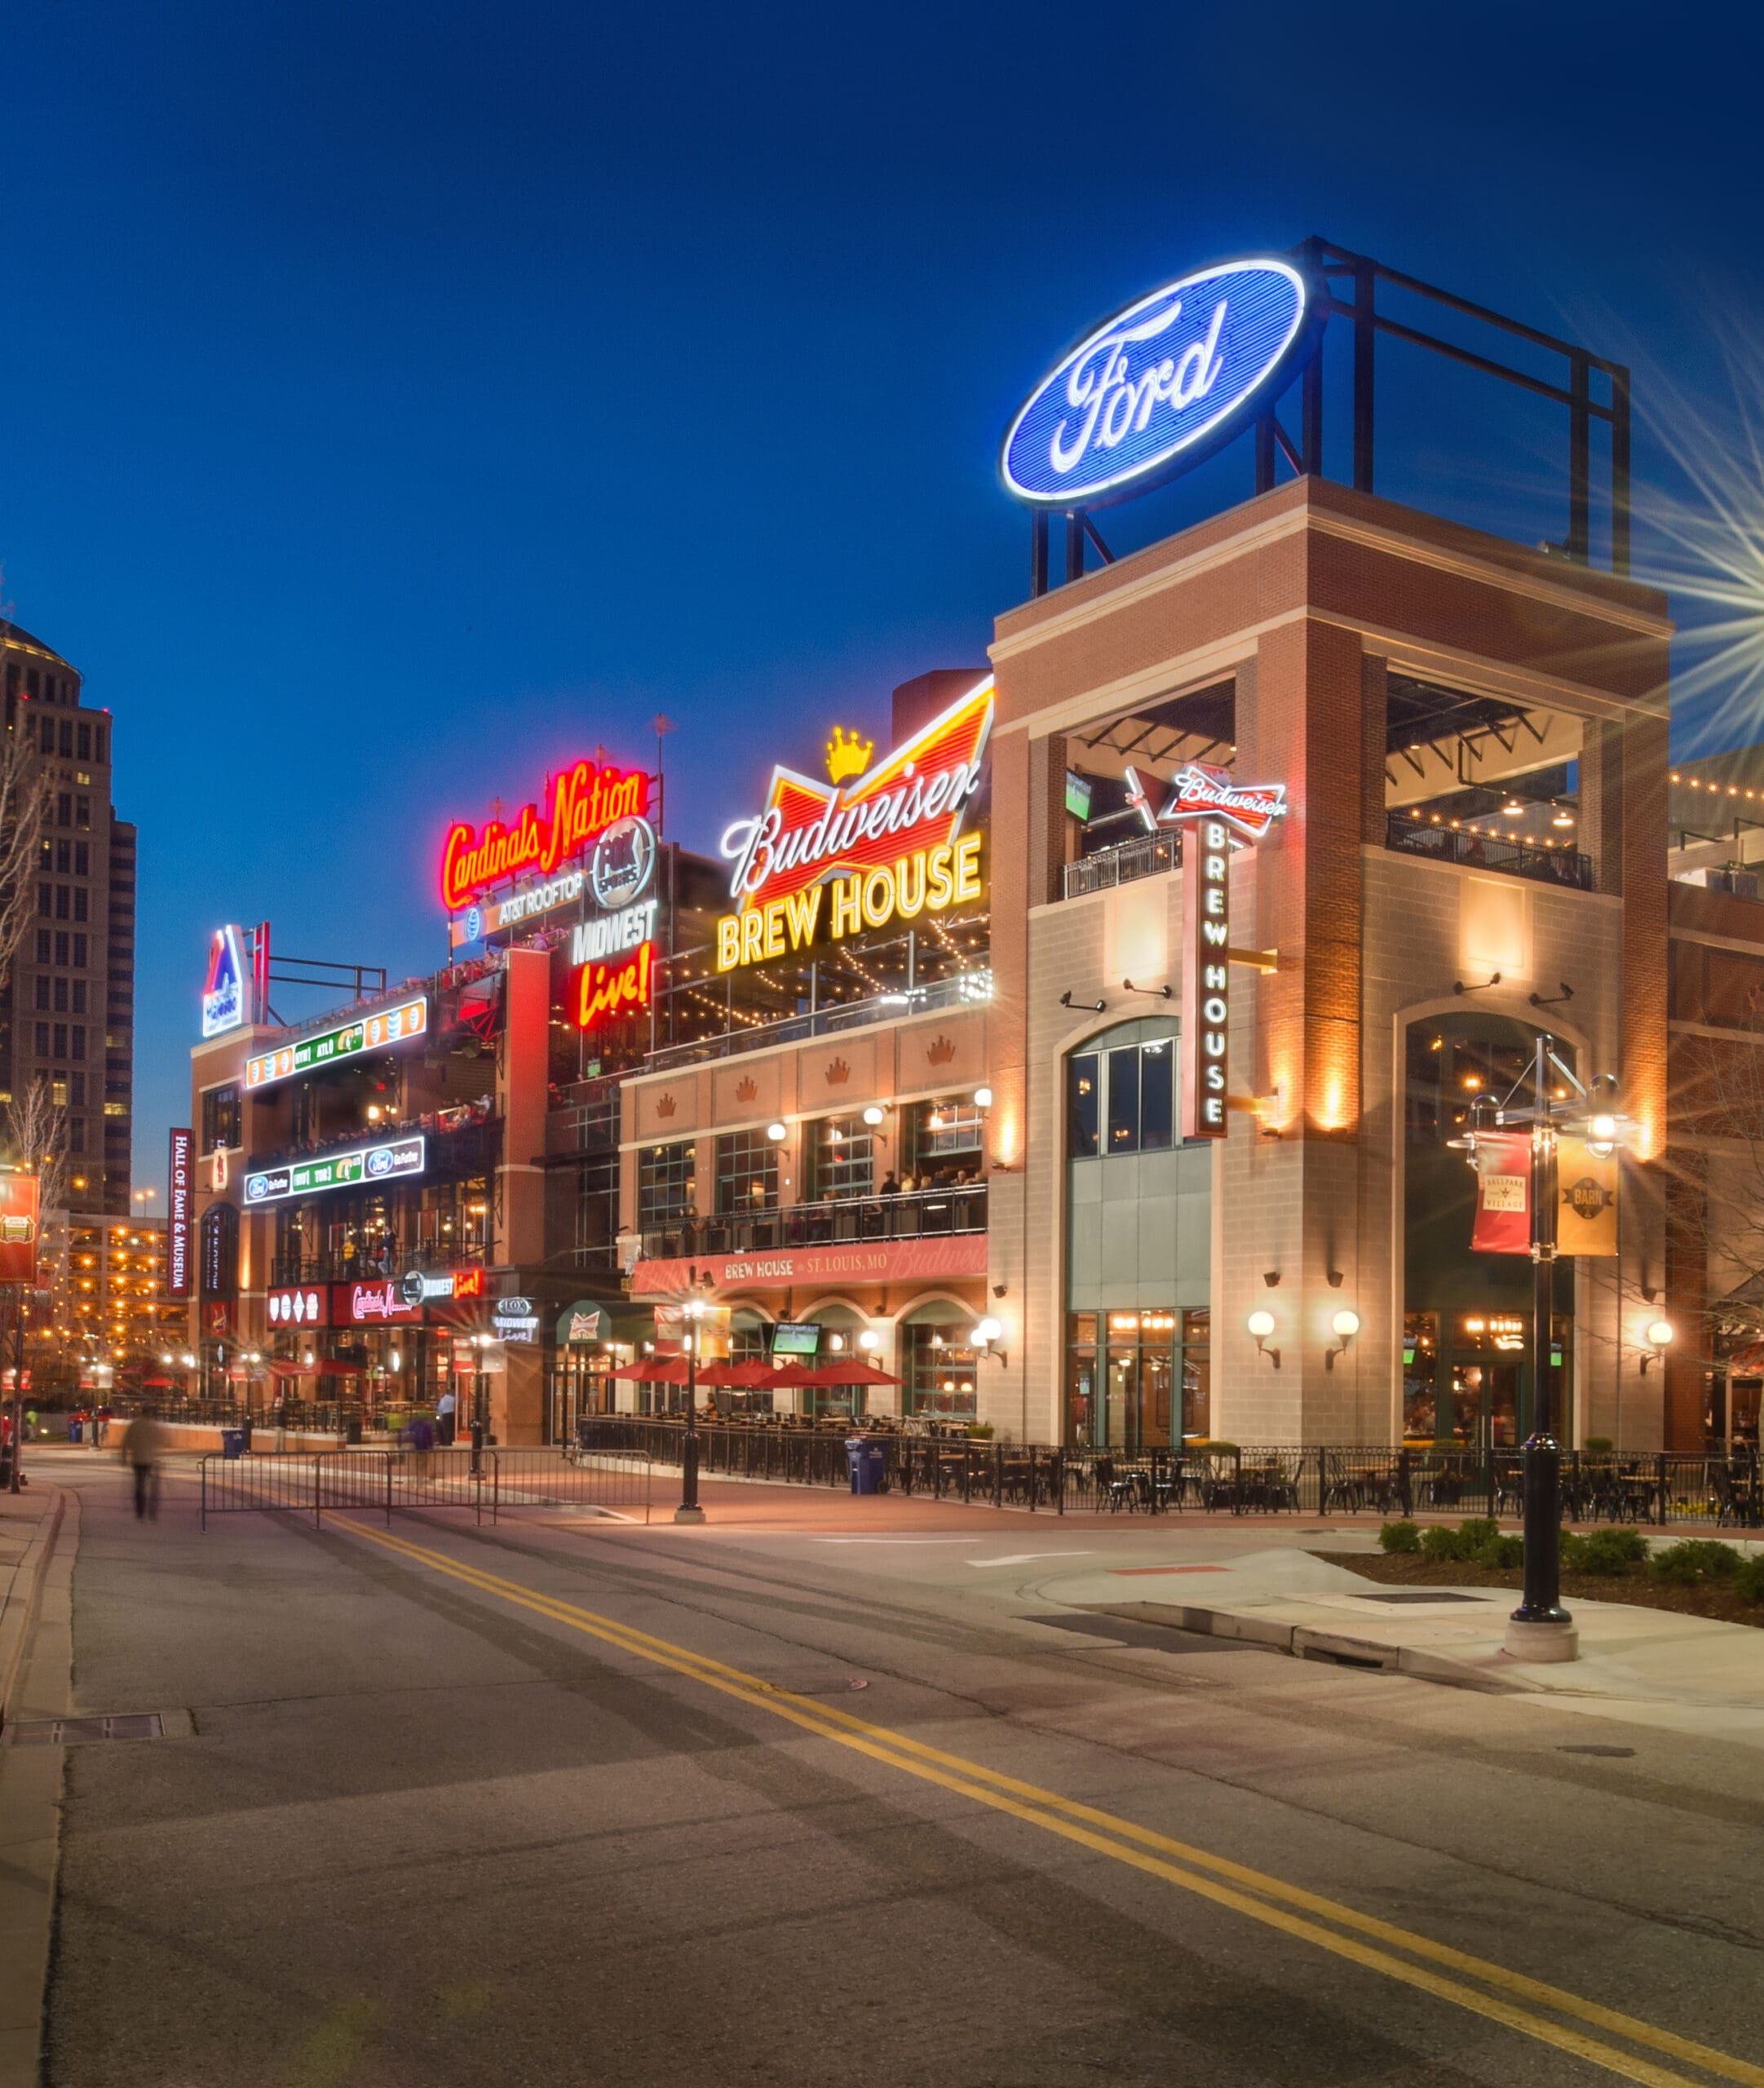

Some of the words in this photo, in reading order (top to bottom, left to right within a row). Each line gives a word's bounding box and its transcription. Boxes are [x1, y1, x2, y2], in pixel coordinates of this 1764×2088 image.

[1050, 299, 1227, 474] Ford
[1175, 773, 1286, 816] Budweiser
[443, 808, 540, 909] Cardinals
[542, 762, 641, 871] Nation
[719, 759, 982, 898] Budweiser
[526, 872, 584, 914] ROOFTOP
[717, 884, 821, 973] BREW
[832, 832, 981, 938] HOUSE
[1205, 822, 1227, 946] BREW
[573, 900, 657, 966] MIDWEST
[580, 941, 651, 1027] Live!
[1204, 964, 1227, 1124] HOUSE
[175, 1135, 188, 1170] HALL
[174, 1170, 186, 1187] OF
[174, 1188, 187, 1220] FAME
[1487, 1200, 1523, 1209] VILLAGE
[174, 1223, 186, 1235] &
[172, 1236, 187, 1289] MUSEUM
[453, 1269, 480, 1299] Live!
[725, 1263, 753, 1279] BREW
[757, 1259, 794, 1277] HOUSE
[807, 1258, 824, 1273] ST.
[826, 1254, 865, 1272] LOUIS,
[867, 1253, 887, 1269] MO
[493, 1318, 538, 1329] MIDWEST
